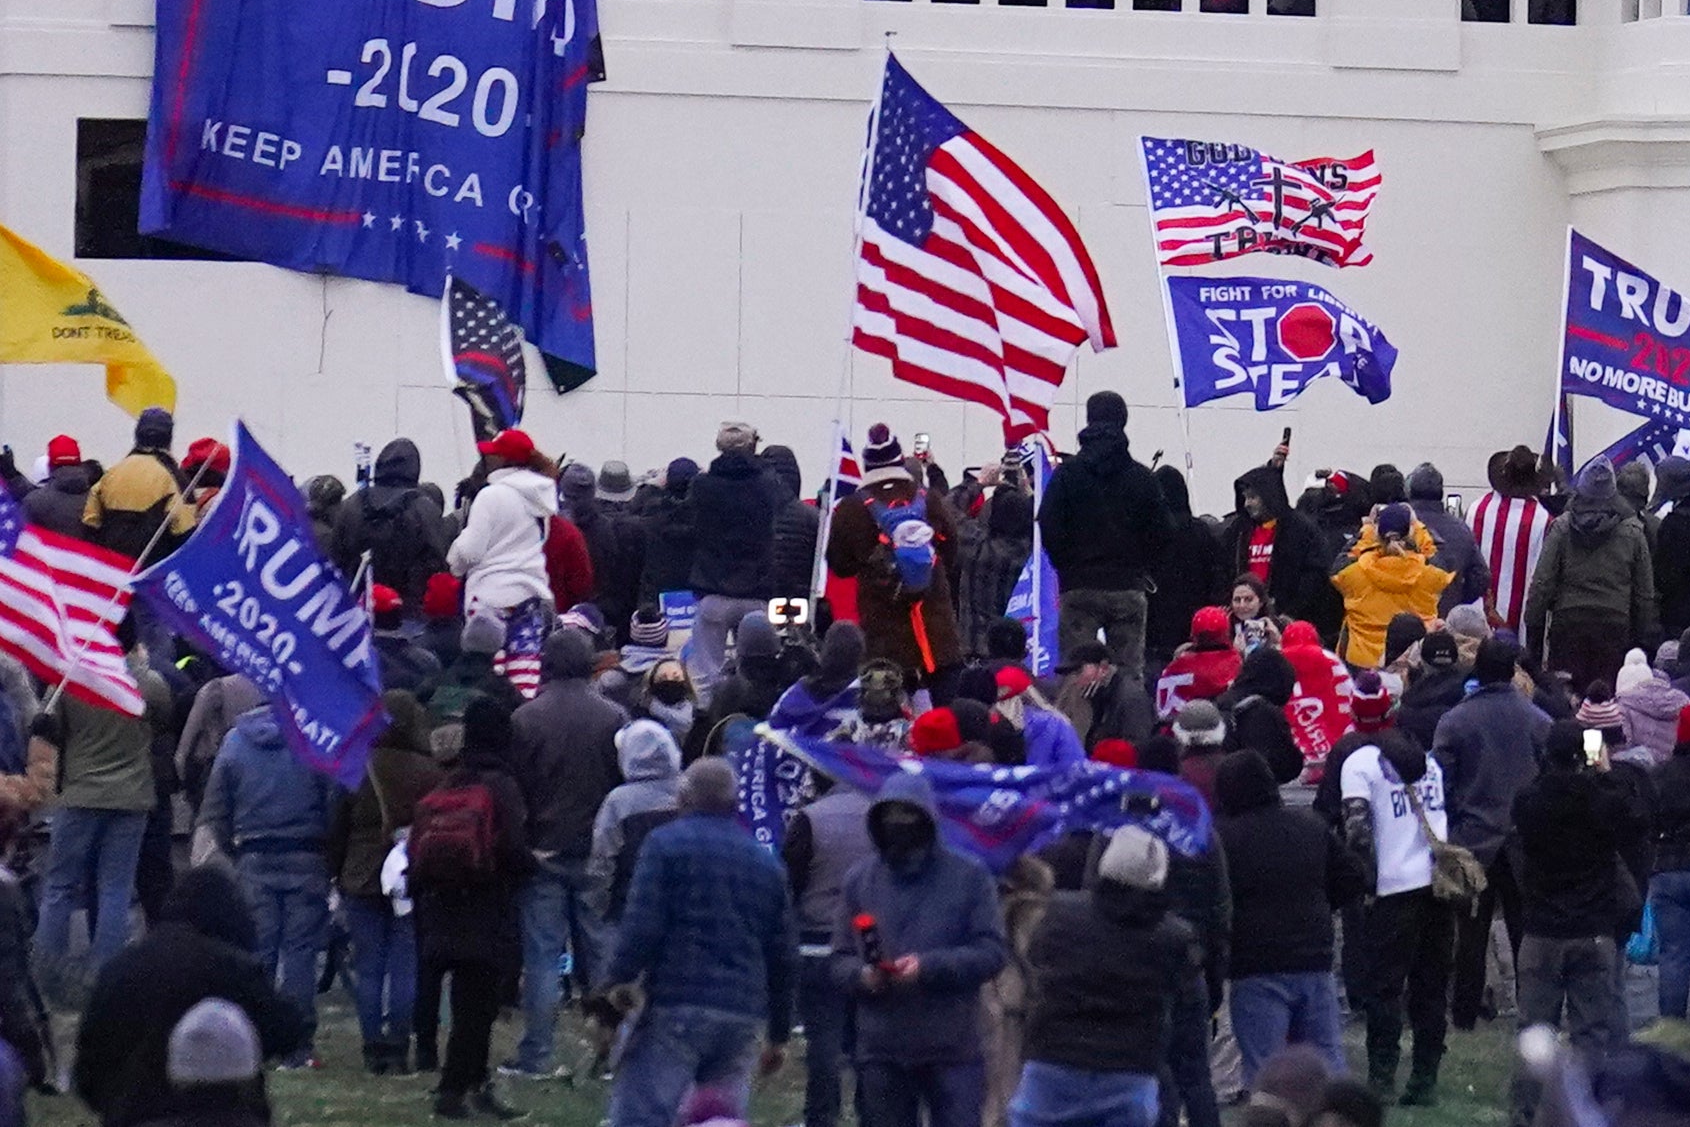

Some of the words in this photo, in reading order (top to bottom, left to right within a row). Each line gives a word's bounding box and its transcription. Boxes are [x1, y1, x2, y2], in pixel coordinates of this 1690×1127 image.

[201, 118, 301, 170] KEEP
[1200, 286, 1251, 302] FIGHT
[1261, 285, 1297, 300] FOR
[1569, 356, 1601, 383] NO
[1602, 366, 1668, 404] MORE
